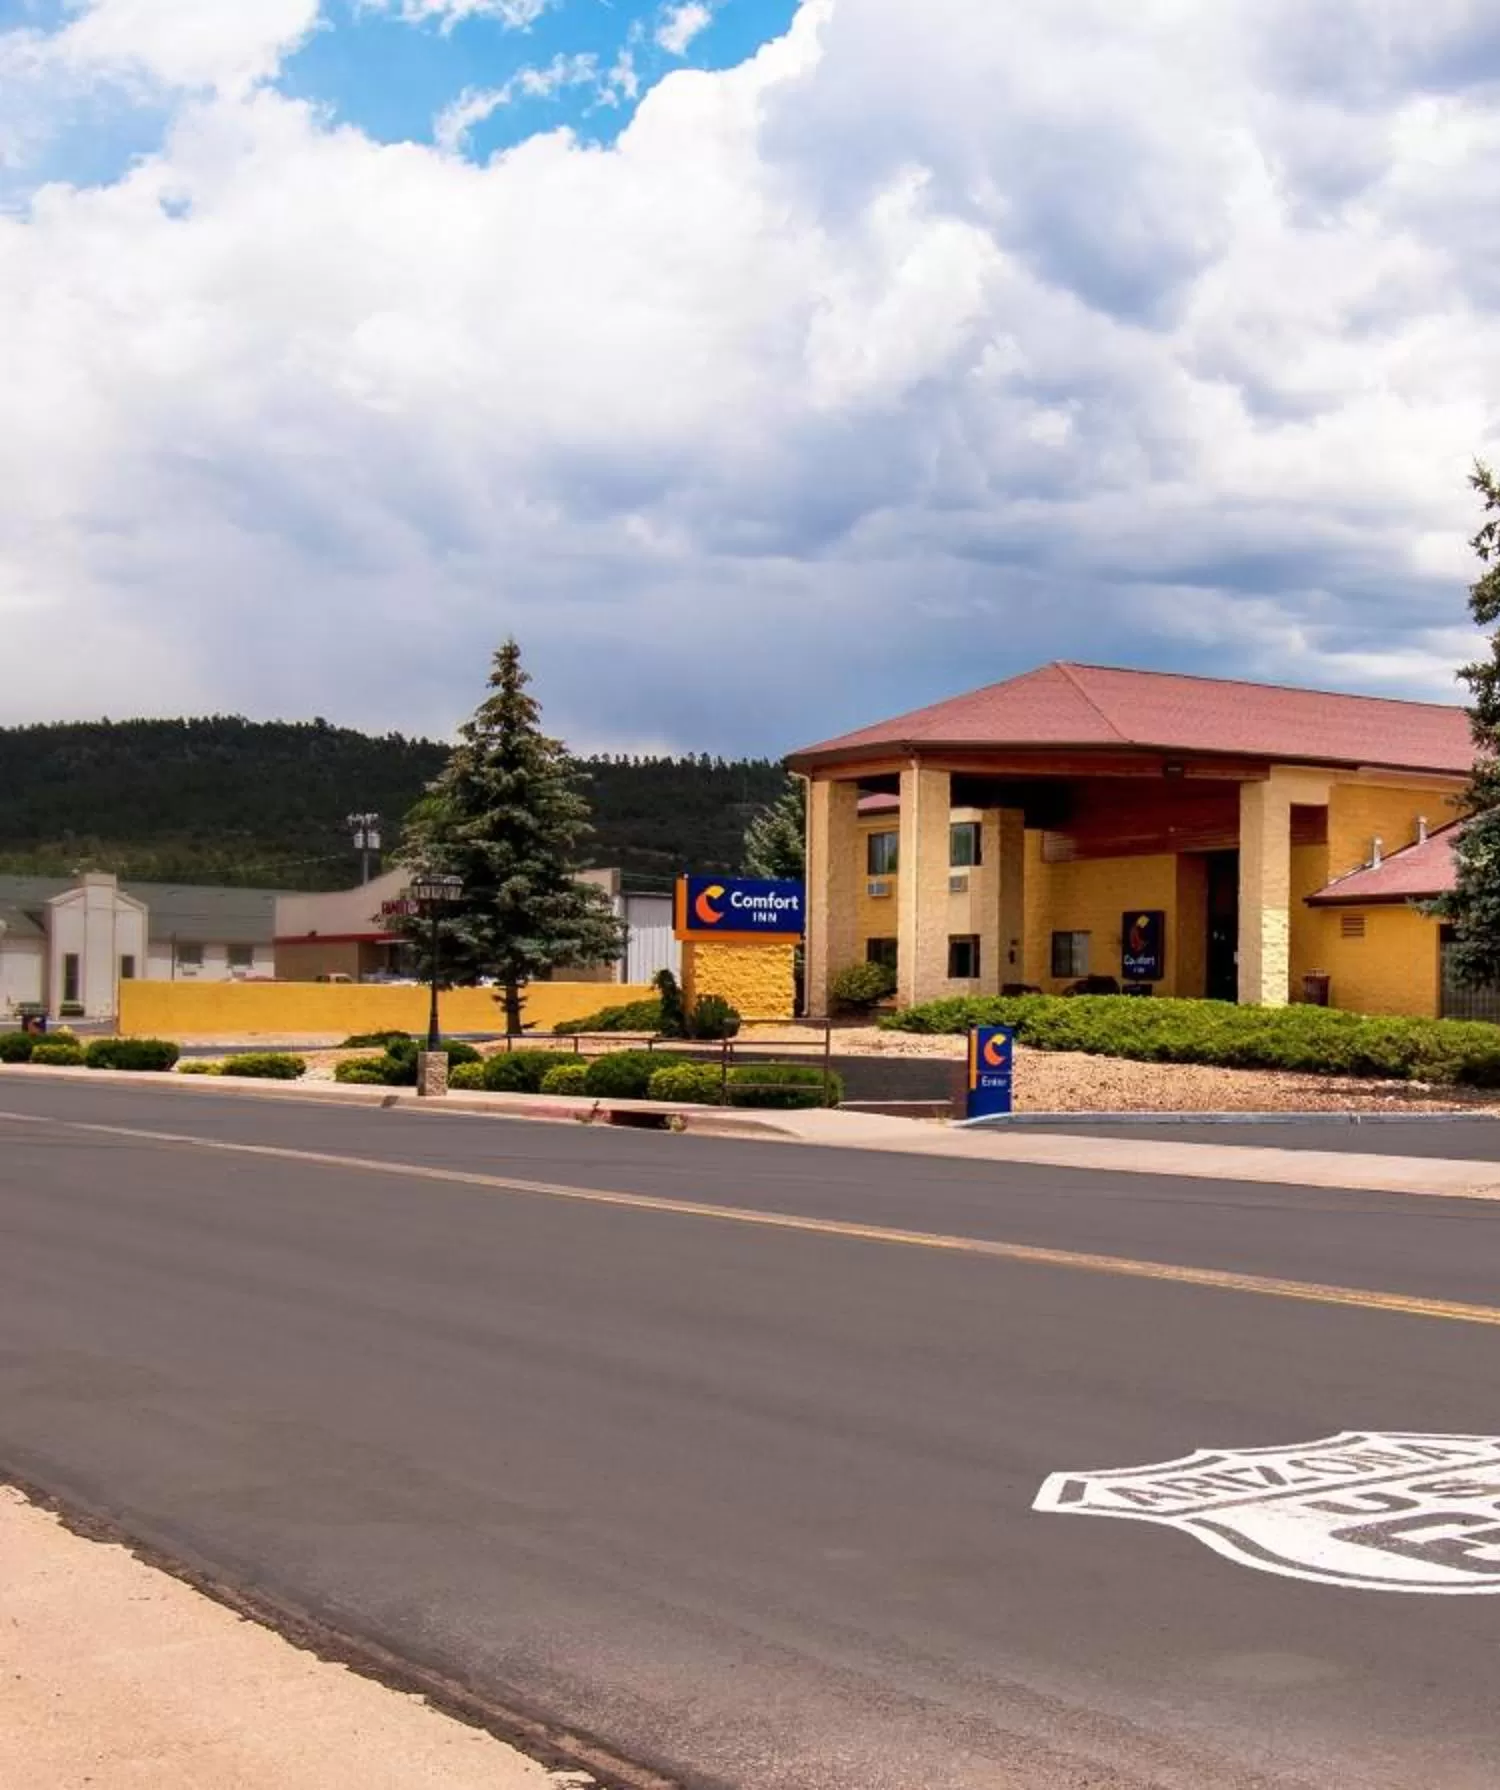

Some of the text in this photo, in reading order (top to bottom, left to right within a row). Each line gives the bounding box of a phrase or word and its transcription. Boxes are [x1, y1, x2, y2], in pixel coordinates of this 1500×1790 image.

[730, 891, 800, 910] Comfort
[752, 912, 778, 923] INN
[981, 1076, 1007, 1087] Enter
[1106, 1444, 1486, 1506] ARIZONA
